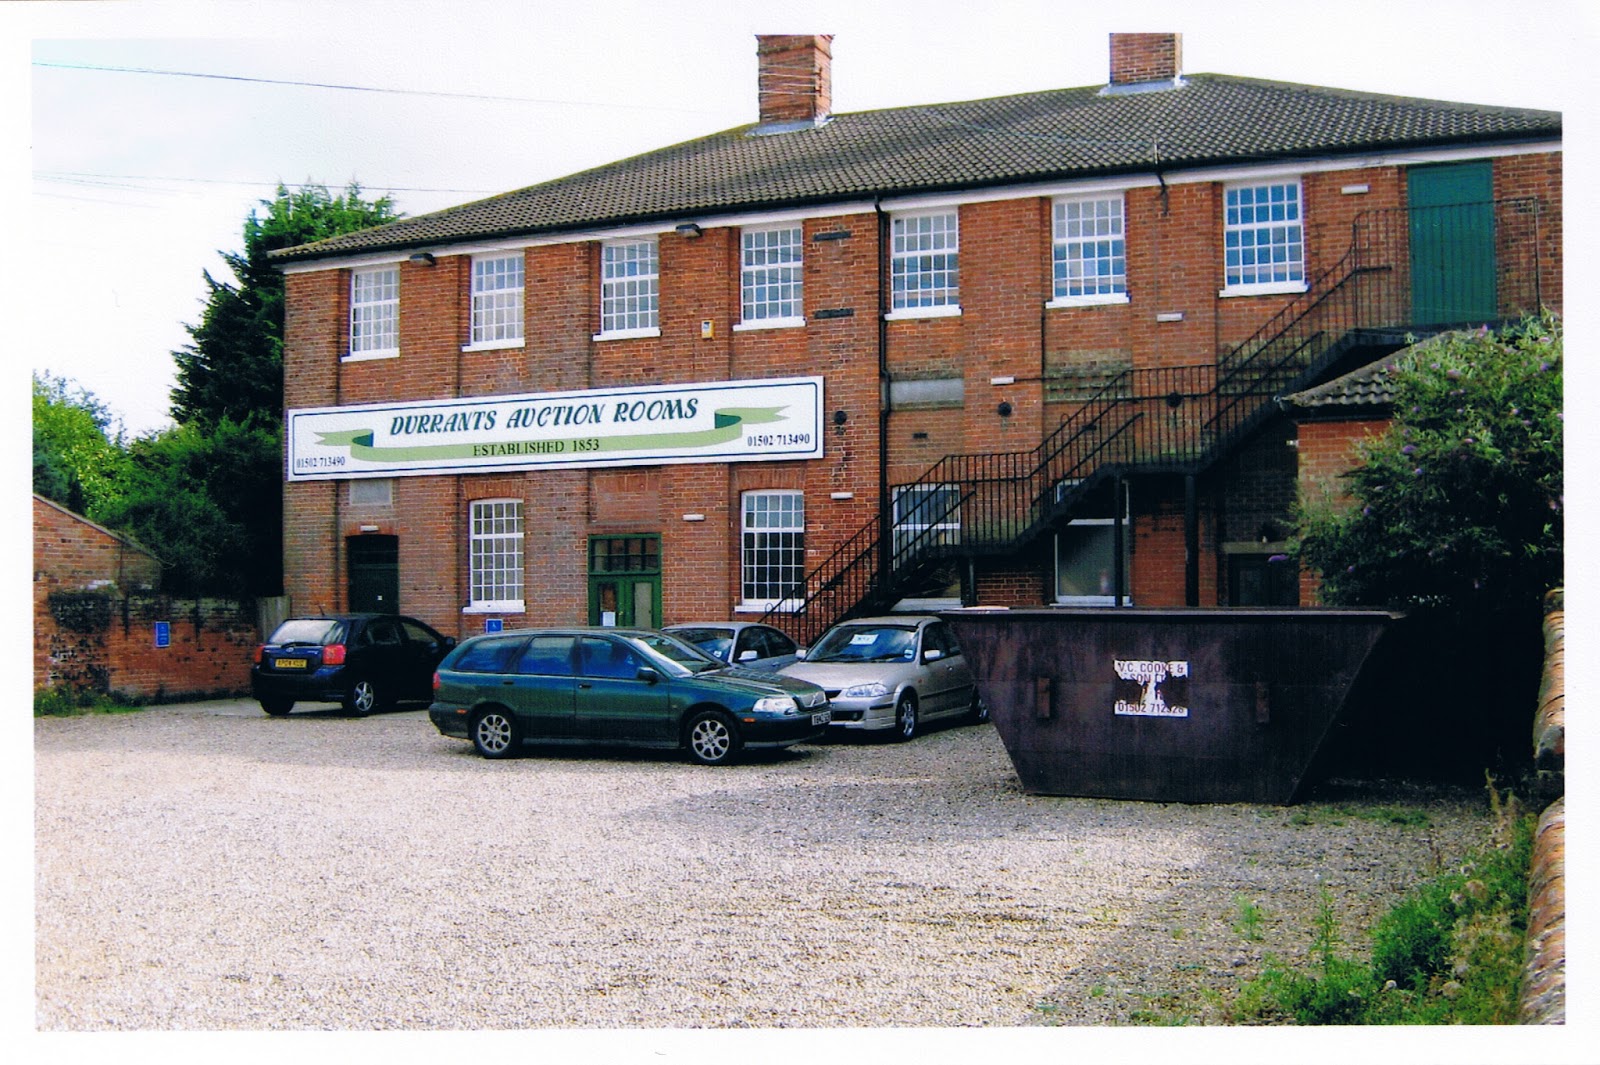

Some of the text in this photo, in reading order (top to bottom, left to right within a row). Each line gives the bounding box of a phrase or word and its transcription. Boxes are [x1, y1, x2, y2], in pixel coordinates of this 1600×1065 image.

[389, 398, 699, 436] DURRANTS AUCTION ROOMS
[473, 438, 600, 456] ESTABLISHED 1853
[747, 433, 810, 447] 01502 713490
[296, 456, 346, 468] 01502 713490
[1140, 663, 1174, 674] COOKE
[1176, 664, 1185, 674] &
